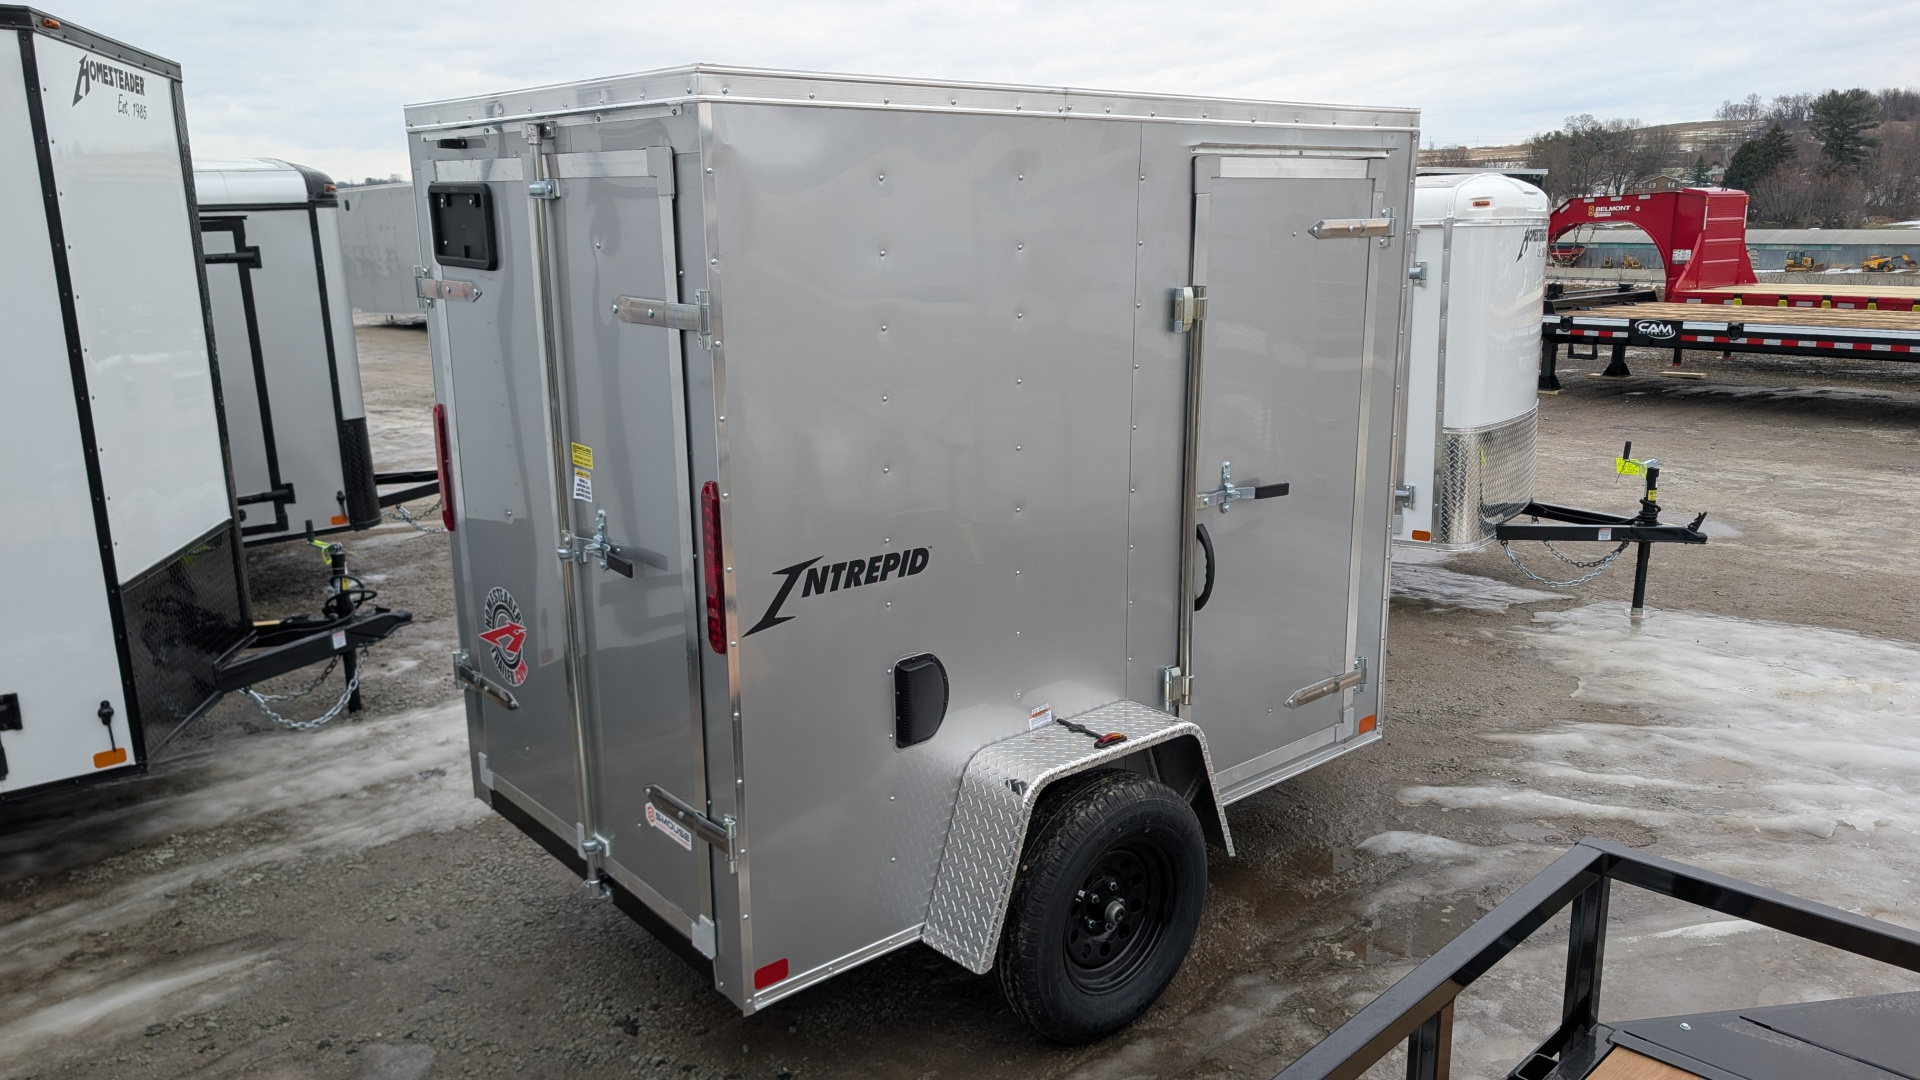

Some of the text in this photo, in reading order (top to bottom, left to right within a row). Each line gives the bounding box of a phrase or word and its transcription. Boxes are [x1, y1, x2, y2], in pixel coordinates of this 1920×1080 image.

[72, 53, 145, 107] HOMESTEADER
[133, 102, 147, 120] 1985
[1638, 322, 1673, 334] CAM
[741, 547, 930, 638] INTREPID
